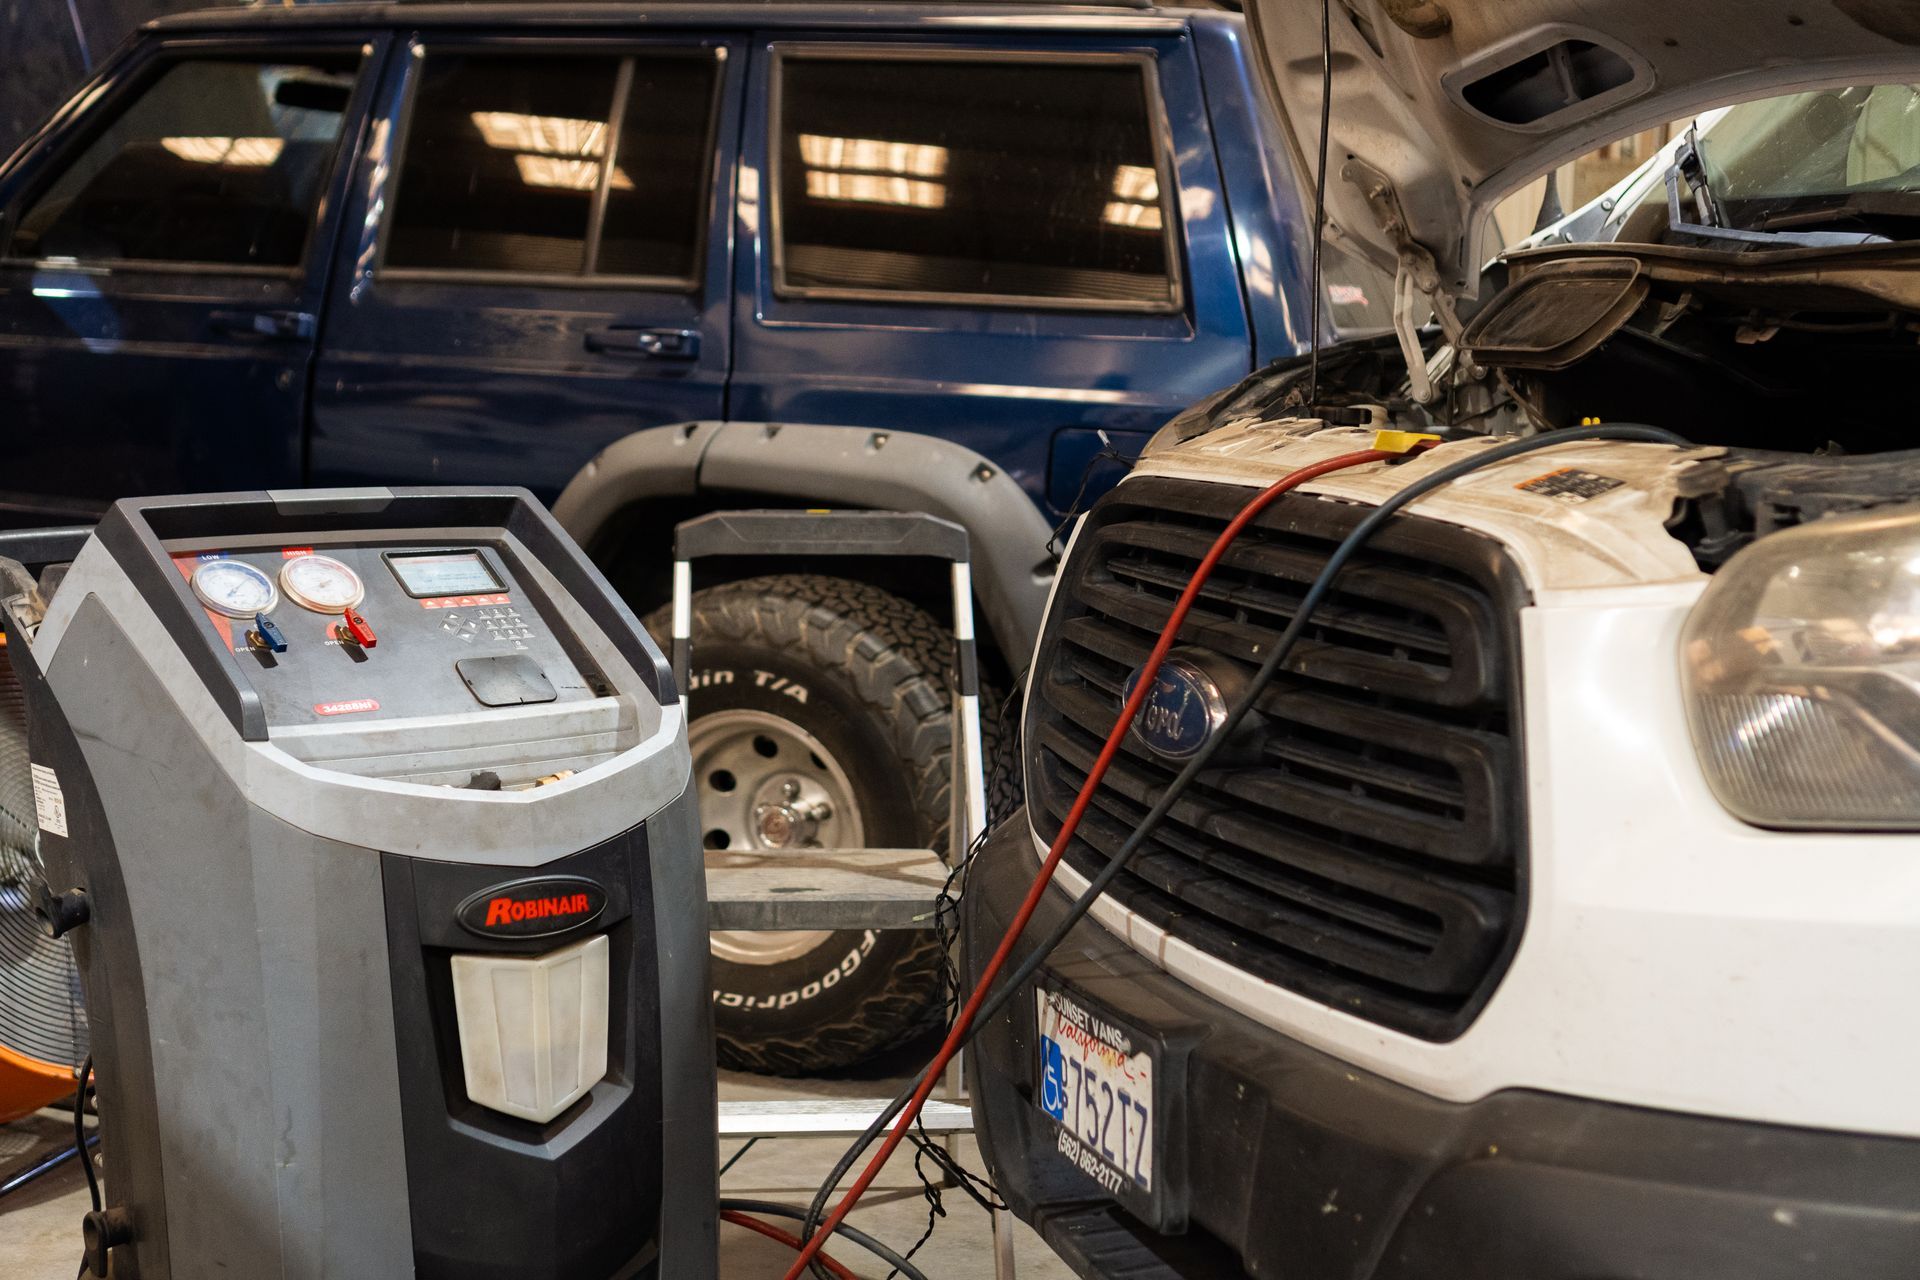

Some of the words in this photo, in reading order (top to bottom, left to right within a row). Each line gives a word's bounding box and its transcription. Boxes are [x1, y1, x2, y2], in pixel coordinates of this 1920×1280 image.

[754, 669, 808, 704] T/A
[713, 928, 882, 1012] FGoodric
[1053, 991, 1090, 1032] SUNSET
[1091, 1016, 1123, 1052] VANS
[1058, 1128, 1080, 1165] (562)
[1080, 1148, 1123, 1195] 862-2177
